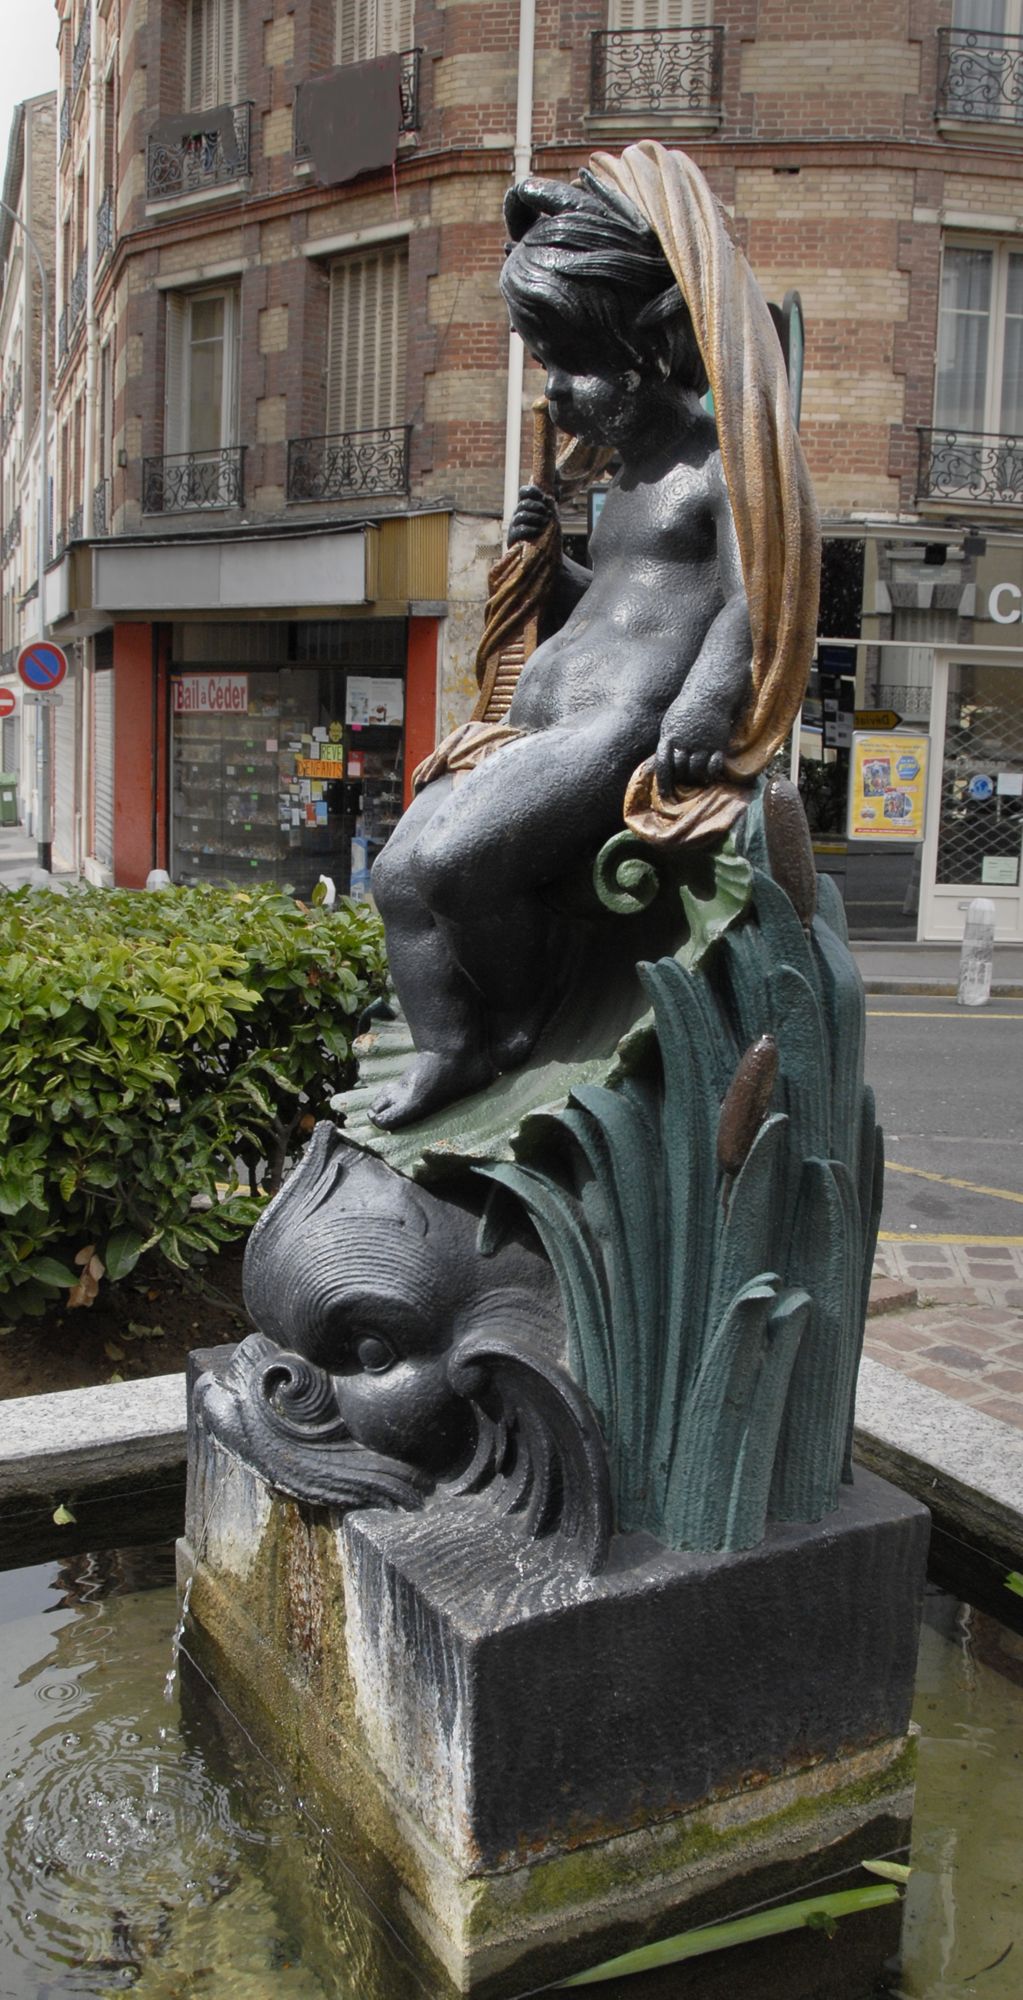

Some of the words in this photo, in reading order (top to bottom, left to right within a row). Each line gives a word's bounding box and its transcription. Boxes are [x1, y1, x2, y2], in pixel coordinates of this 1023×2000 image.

[988, 582, 1023, 624] C
[177, 679, 199, 709] Bail
[200, 685, 207, 705] à
[208, 677, 246, 709] Céder
